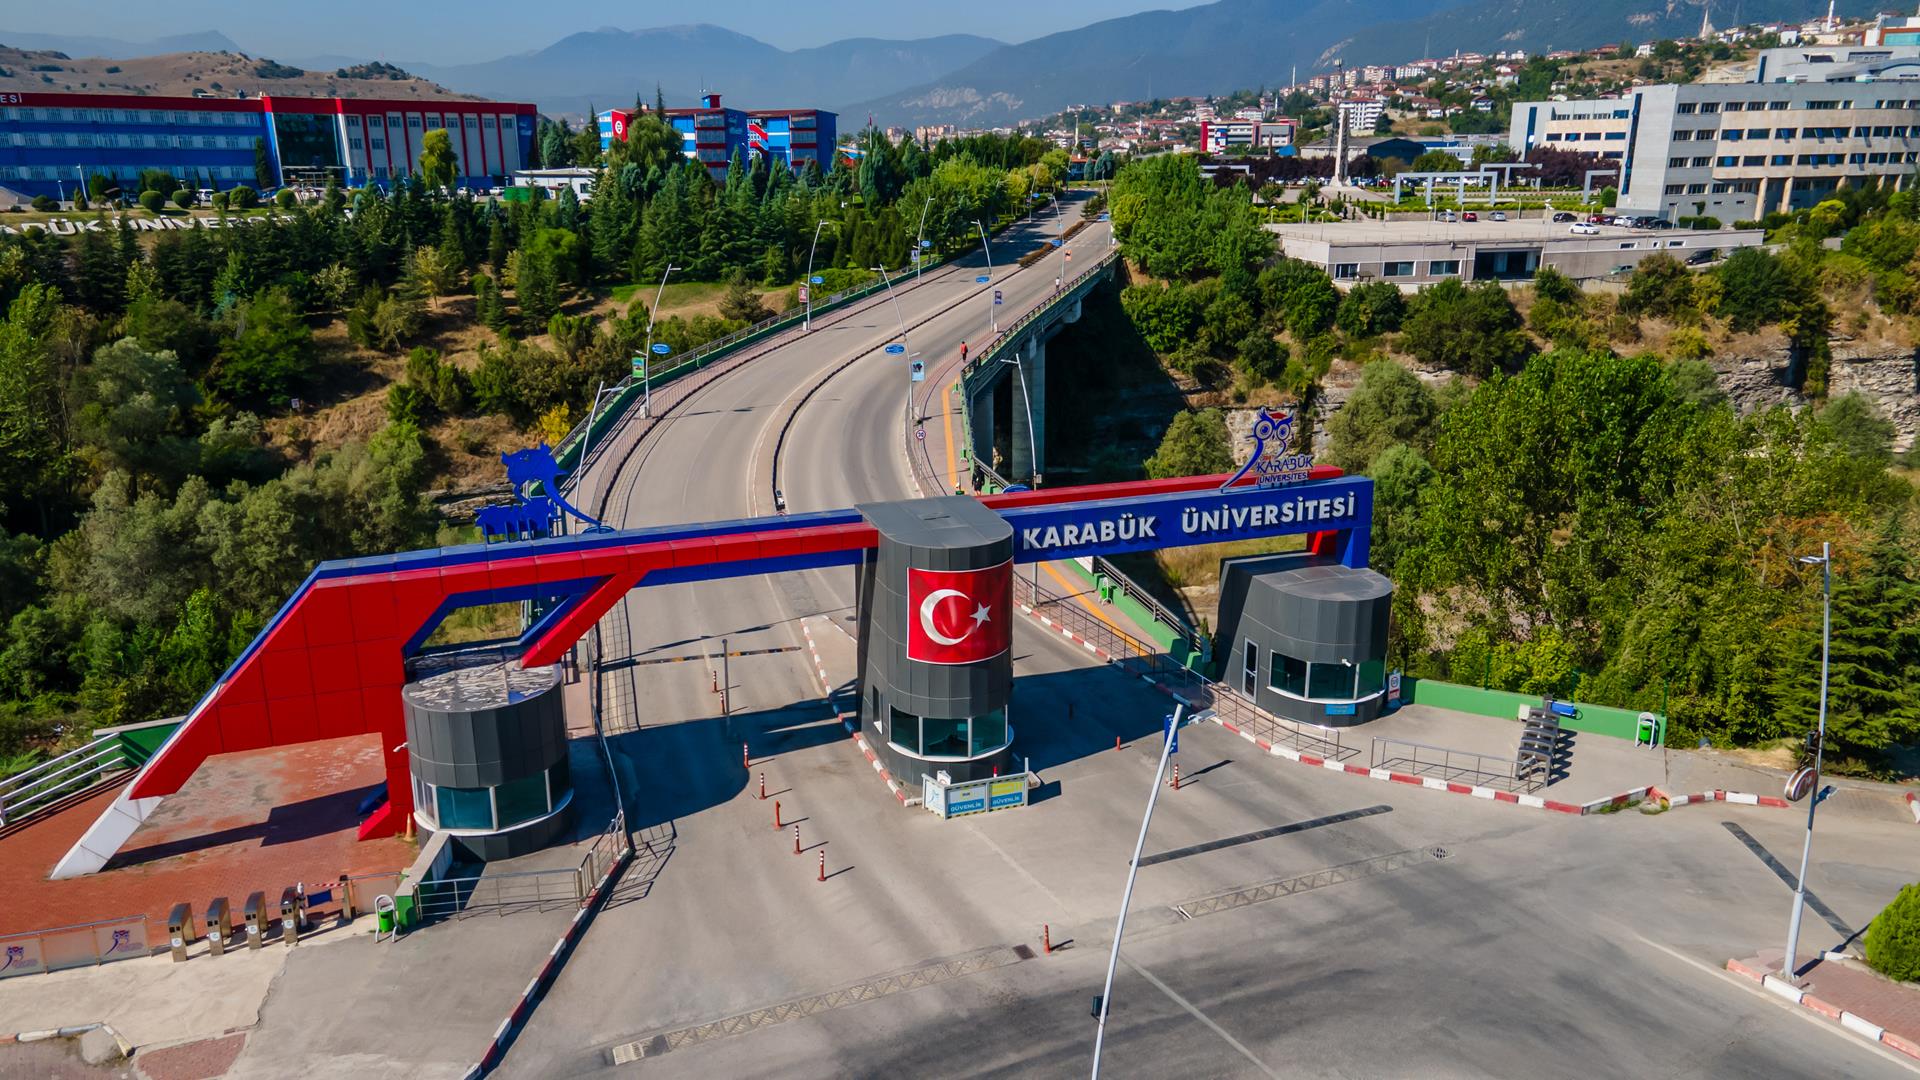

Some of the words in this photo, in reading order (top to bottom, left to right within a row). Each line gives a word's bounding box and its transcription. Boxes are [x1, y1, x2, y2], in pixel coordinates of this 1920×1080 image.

[1257, 454, 1313, 473] KARABÜK
[1023, 513, 1156, 550] KARABÜK
[1181, 491, 1355, 534] ÜNİVERSİTESİ
